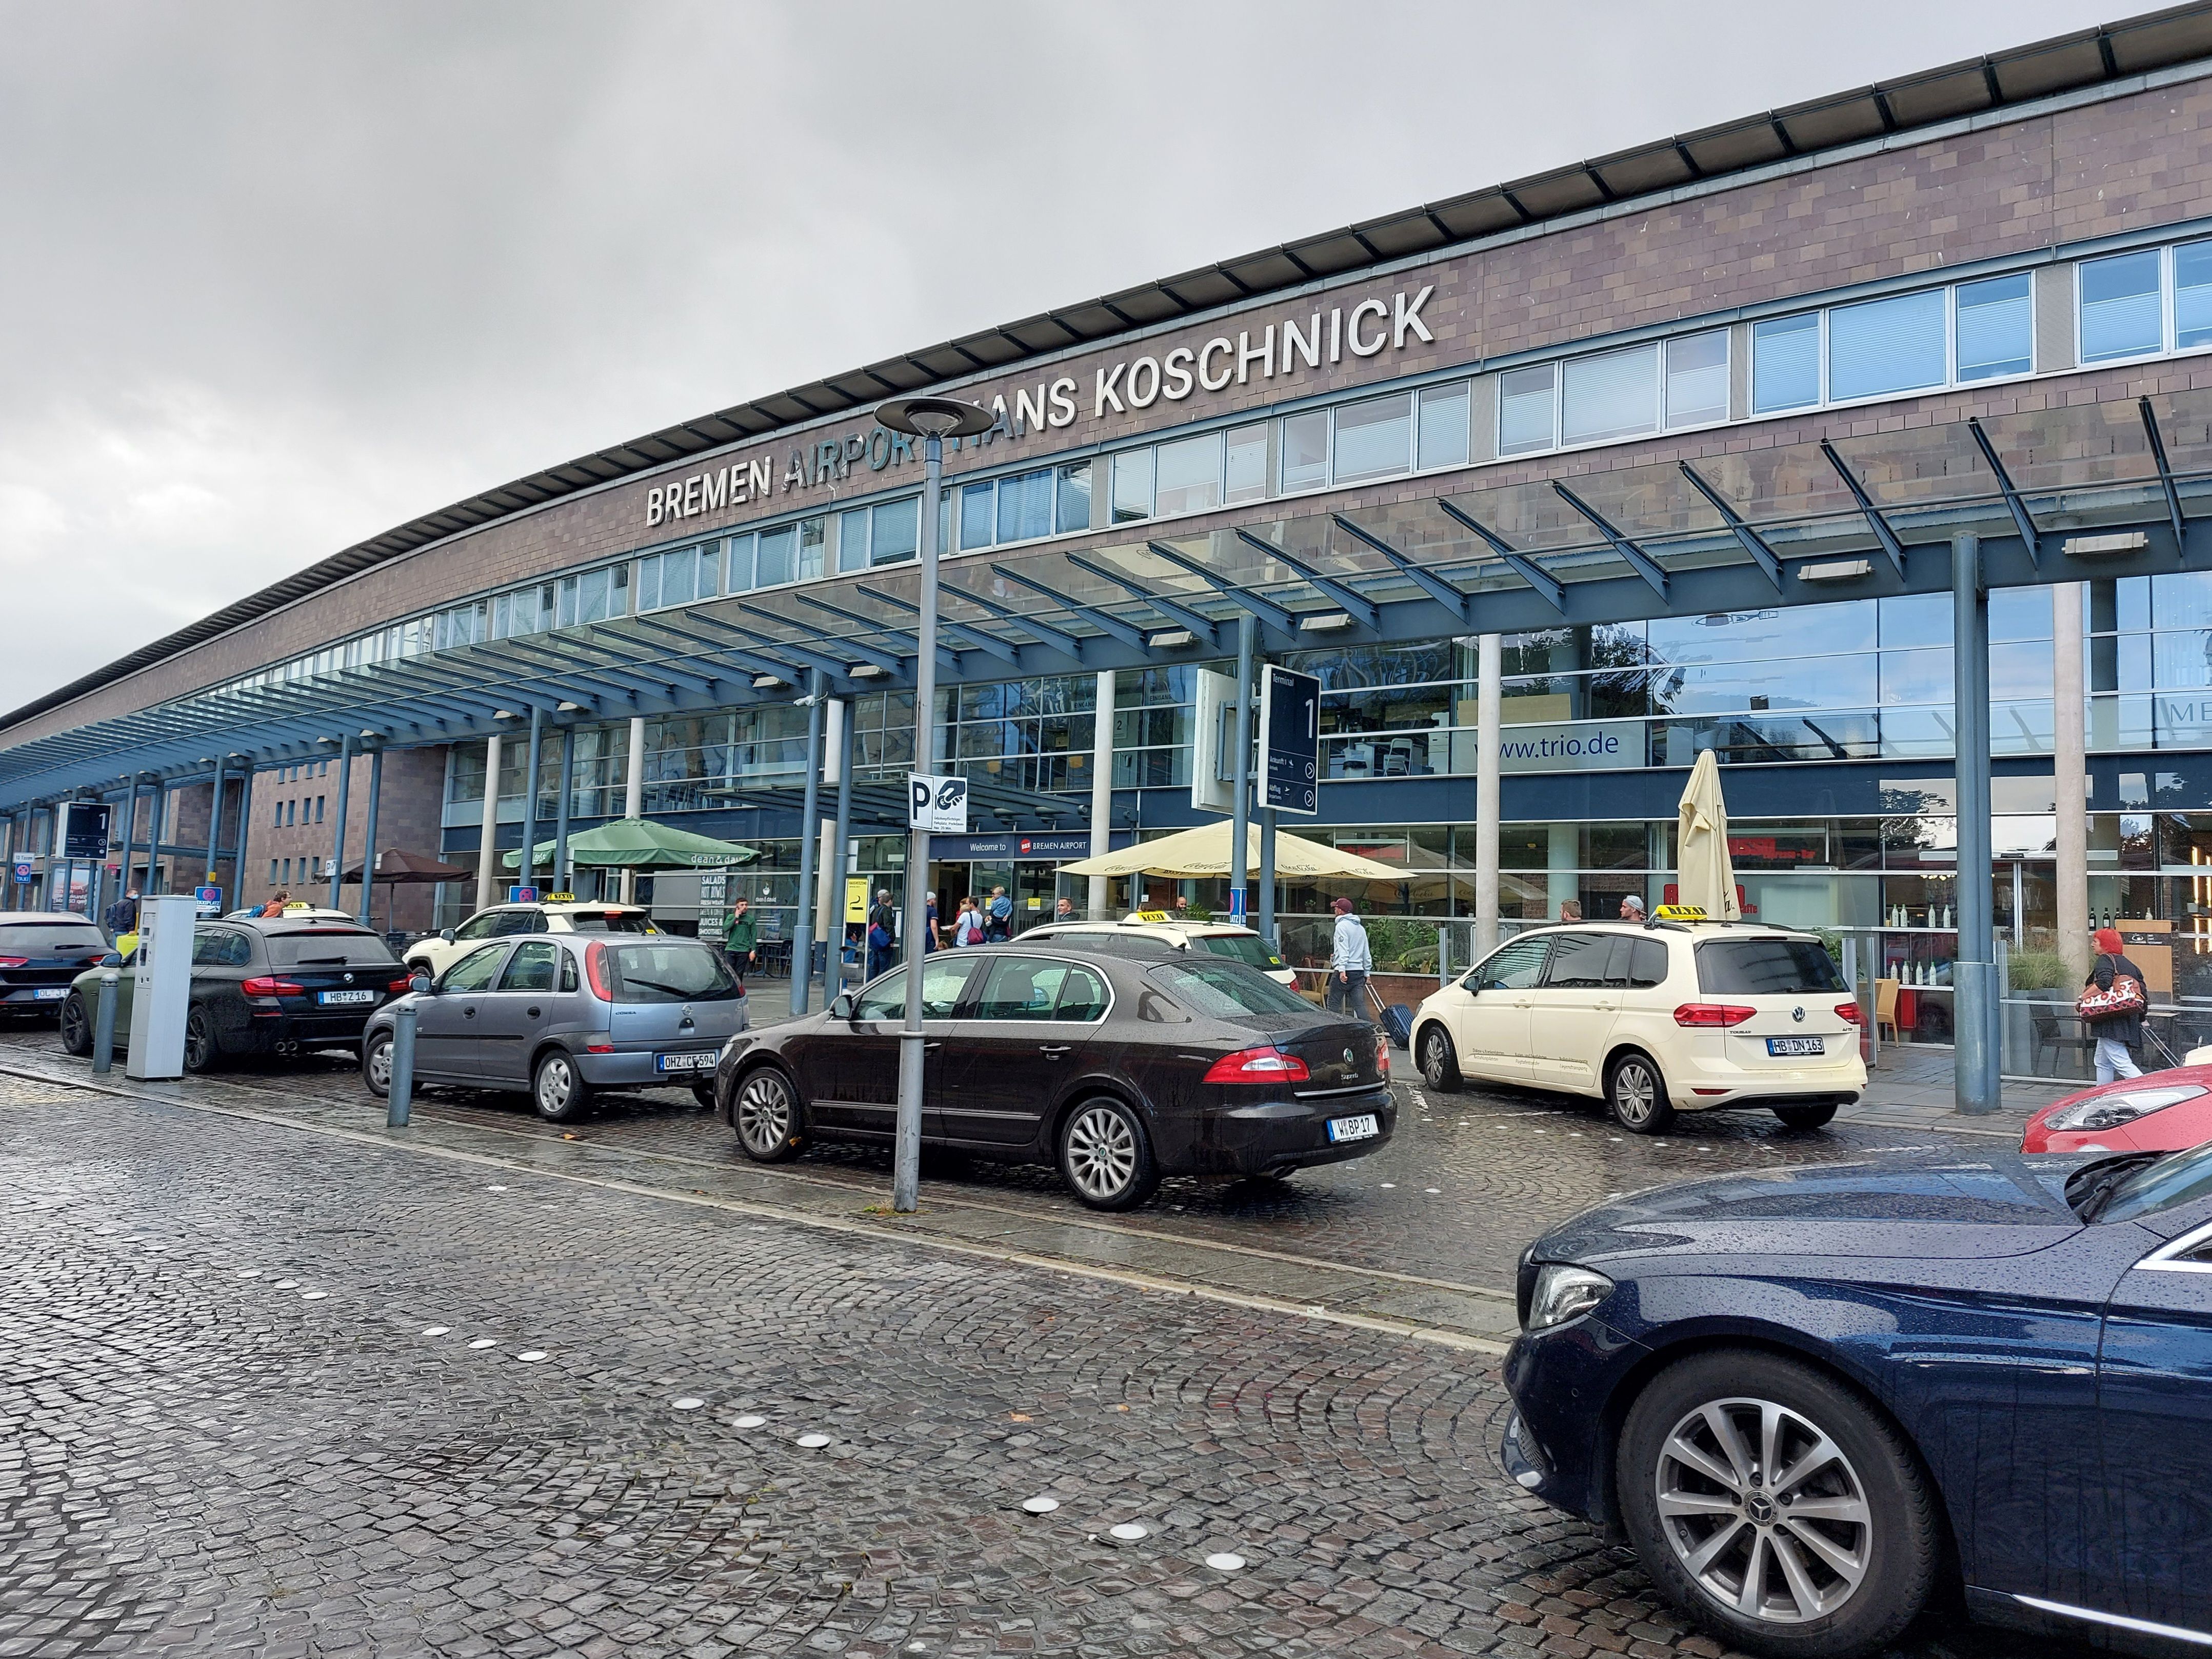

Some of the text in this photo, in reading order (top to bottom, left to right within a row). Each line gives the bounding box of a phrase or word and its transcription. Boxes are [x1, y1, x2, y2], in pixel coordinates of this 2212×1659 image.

[646, 455, 773, 526] BREMEN
[781, 426, 918, 492] AIRPOR
[1094, 285, 1436, 418] KOSCHNICK
[1272, 673, 1294, 686] Terminal
[1305, 698, 1313, 738] 1
[1117, 720, 1122, 730] 2
[1474, 731, 1619, 758] ww.trio.de
[912, 781, 931, 821] P
[98, 813, 106, 830] 1
[969, 843, 998, 851] Welcome
[999, 843, 1006, 851] to
[1059, 841, 1087, 849] AIRPORT
[691, 854, 714, 864] dean
[715, 855, 723, 864] &
[701, 875, 726, 885] SALADS
[701, 886, 725, 898] HOT BOWLS
[1670, 906, 1704, 915] TAXI
[699, 918, 723, 926] JUICES &
[330, 993, 343, 1002] HB
[1773, 1041, 1787, 1052] HB
[665, 1057, 681, 1068] OHZ
[1337, 1121, 1345, 1136] W
